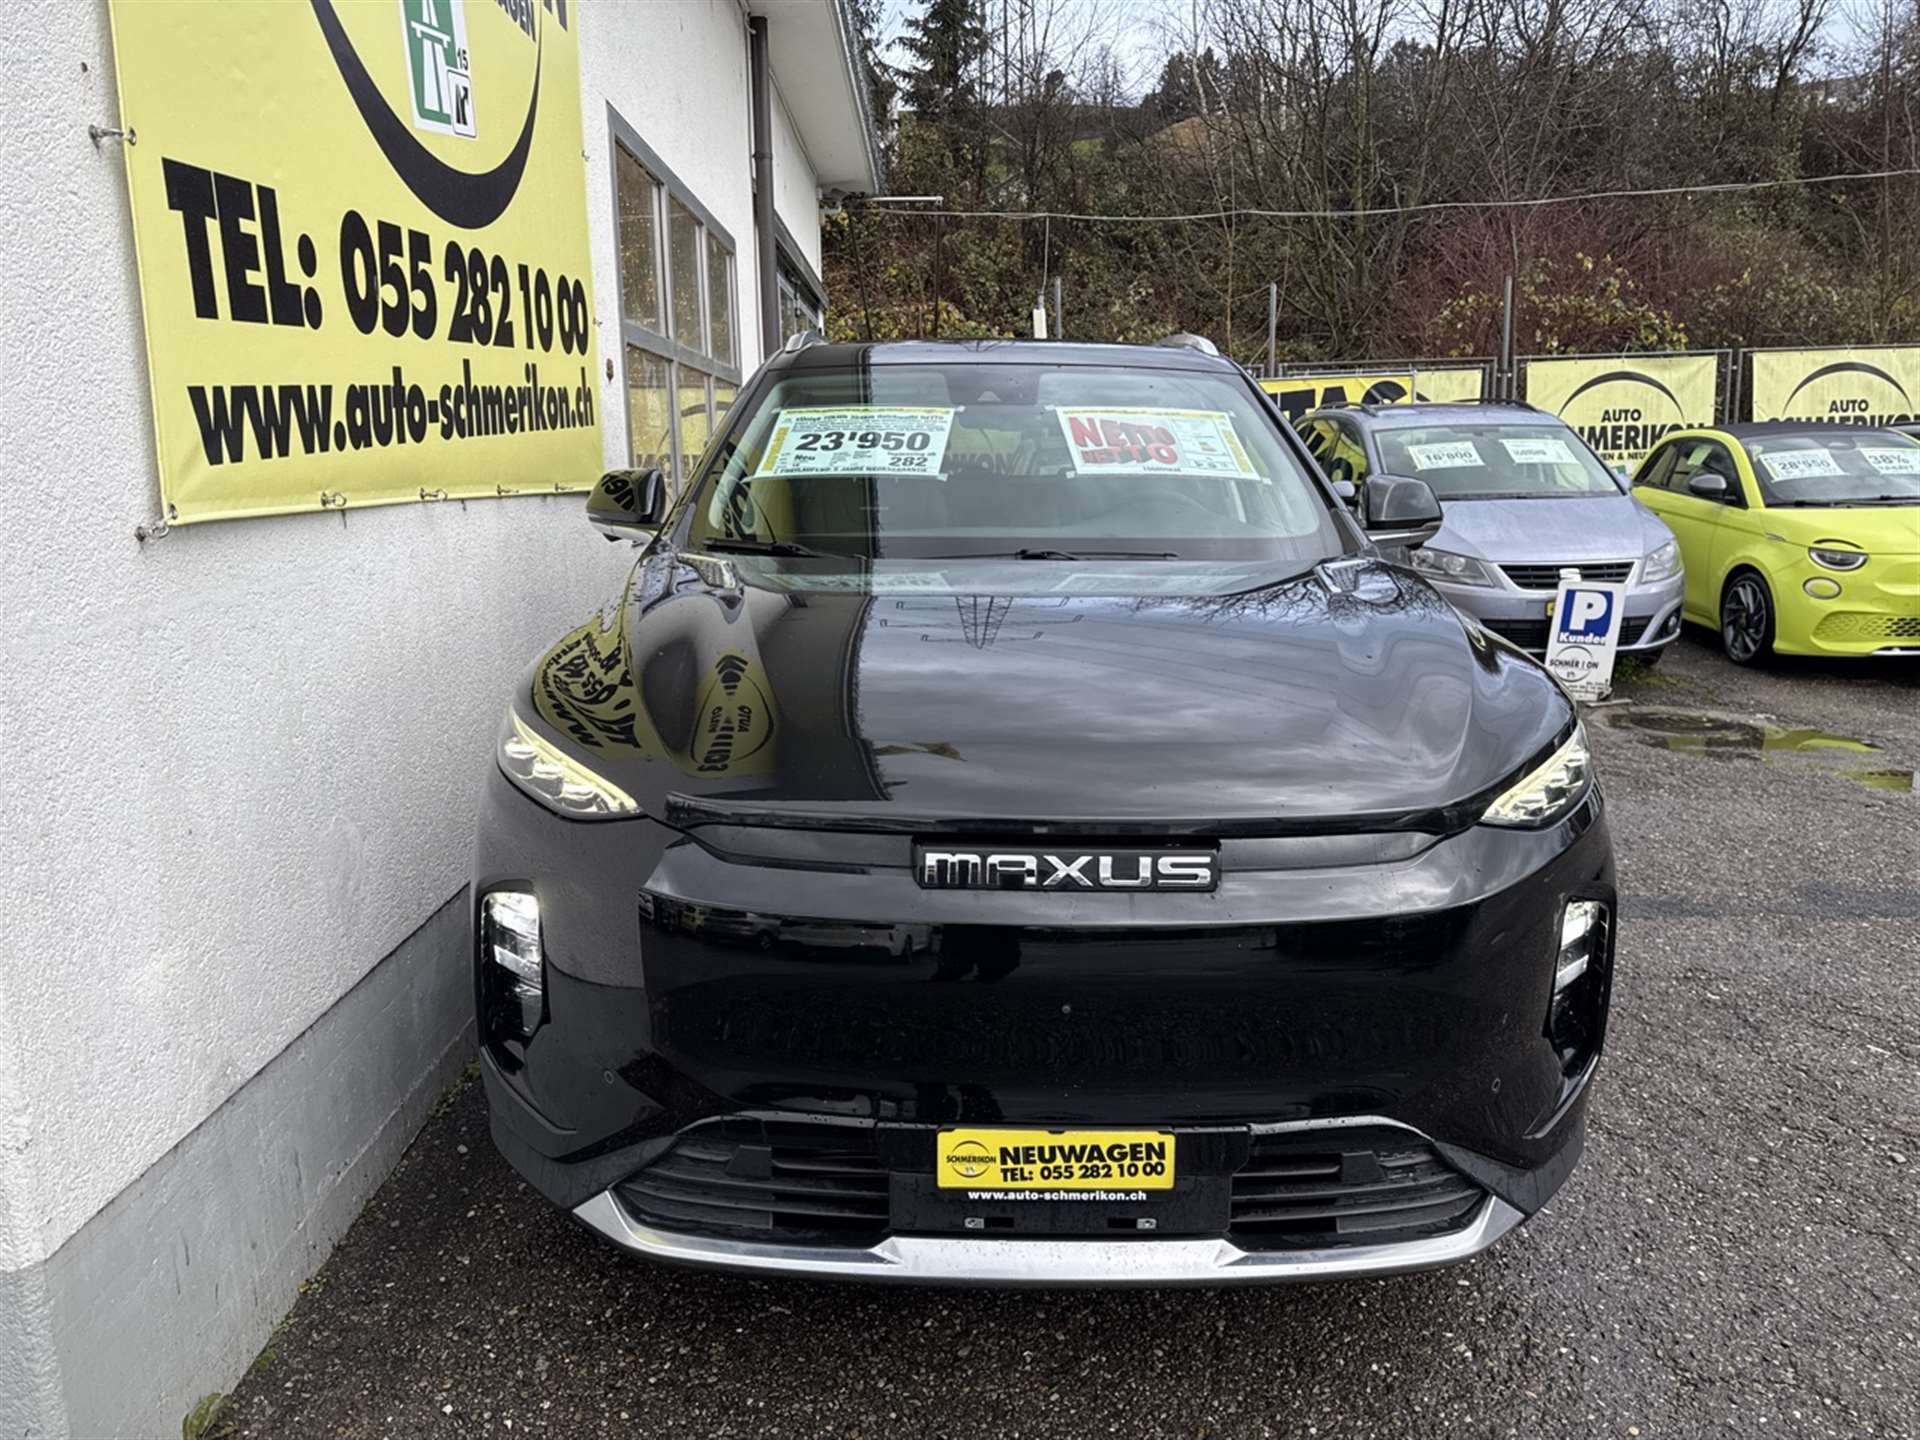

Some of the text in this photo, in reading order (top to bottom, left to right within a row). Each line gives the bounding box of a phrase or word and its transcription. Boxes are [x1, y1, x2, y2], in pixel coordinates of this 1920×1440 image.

[457, 48, 468, 71] 15
[162, 157, 588, 355] TEL: 055 282 10 00
[187, 358, 594, 466] www.auto-schmerikon.ch
[1601, 409, 1641, 422] AUTO
[1829, 400, 1869, 413] AUTO
[795, 431, 931, 452] 23'950
[1068, 416, 1176, 448] NETTO
[888, 456, 928, 467] 282
[1868, 455, 1910, 464] 38%
[1569, 591, 1608, 631] P
[925, 853, 1211, 887] MAXUS
[946, 1155, 996, 1163] SCHMERIKON
[1000, 1142, 1166, 1165] NEUWAGEN
[1001, 1162, 1165, 1182] TEL: 055 282 10 00
[968, 1190, 1147, 1201] www.auto-schmerikon.ch
